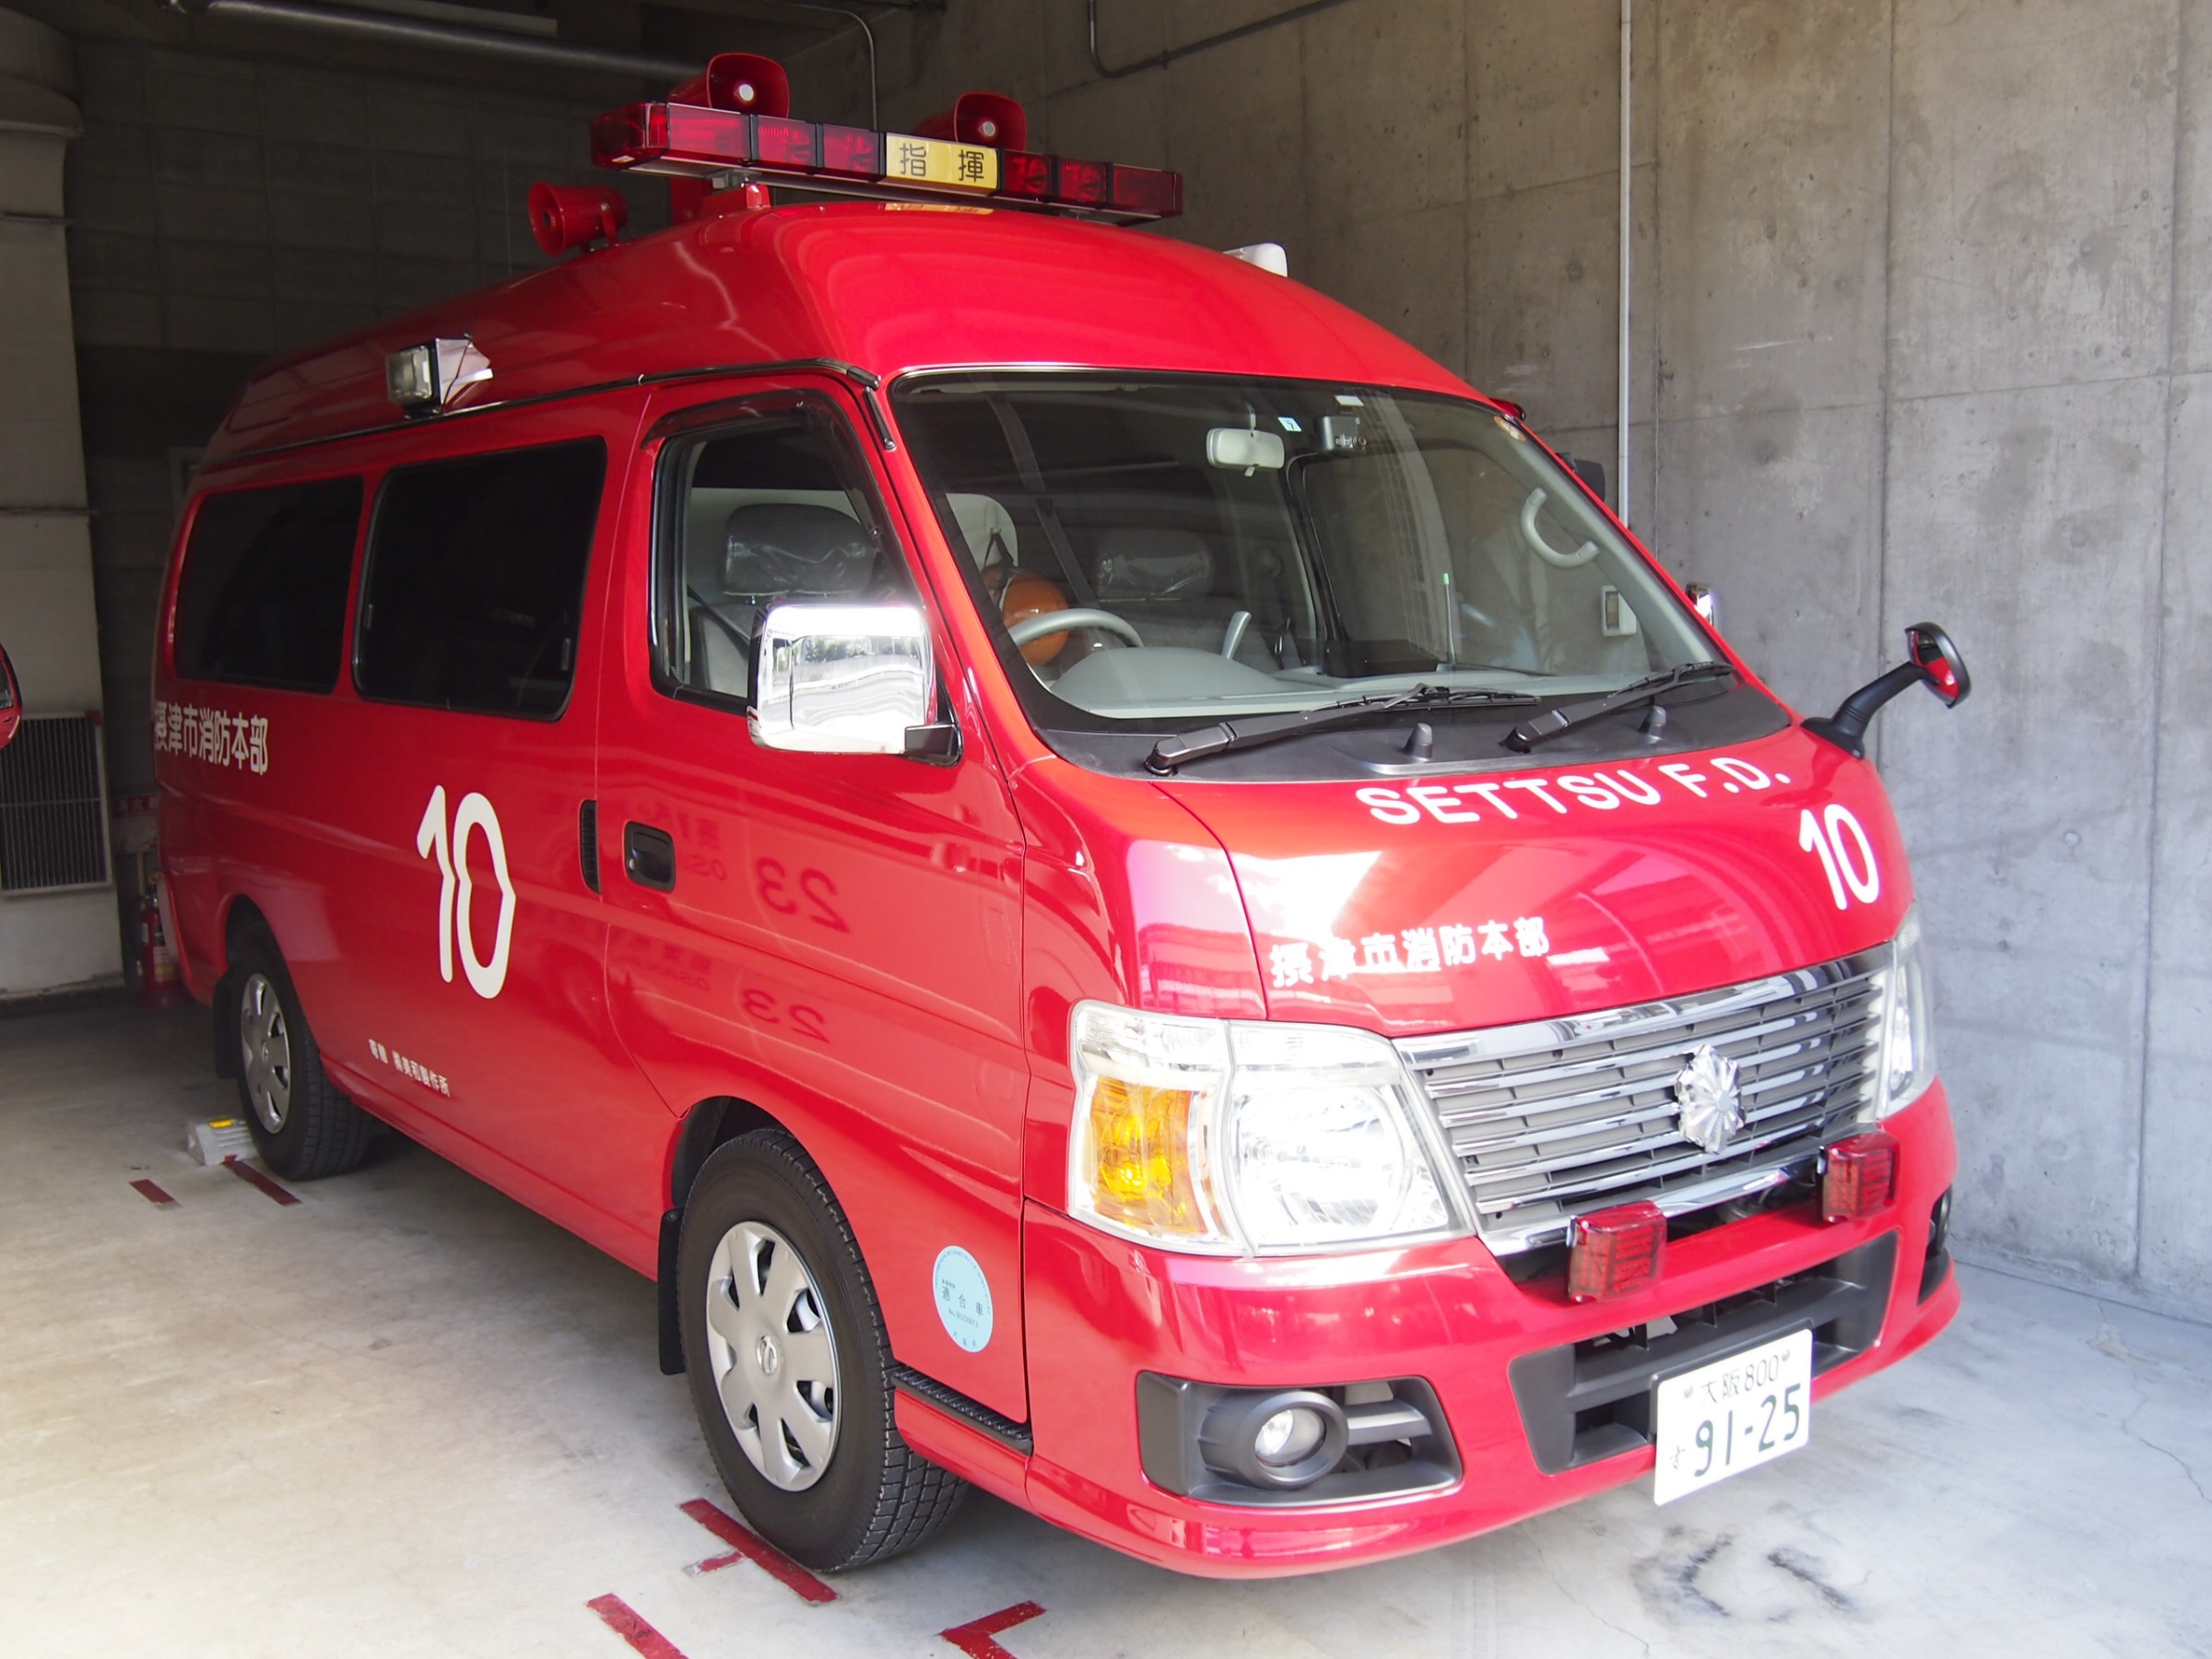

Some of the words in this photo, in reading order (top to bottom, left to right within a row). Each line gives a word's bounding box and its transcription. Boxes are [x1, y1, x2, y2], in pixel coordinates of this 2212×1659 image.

[900, 143, 984, 182] 指揮
[1355, 769, 1661, 825] SETTSU
[1658, 757, 1792, 798] F.D.
[417, 784, 516, 999] 10
[1799, 804, 1879, 911] 10
[1269, 916, 1549, 988] 摂津市消防本部
[1694, 1382, 1801, 1477] 91-25
